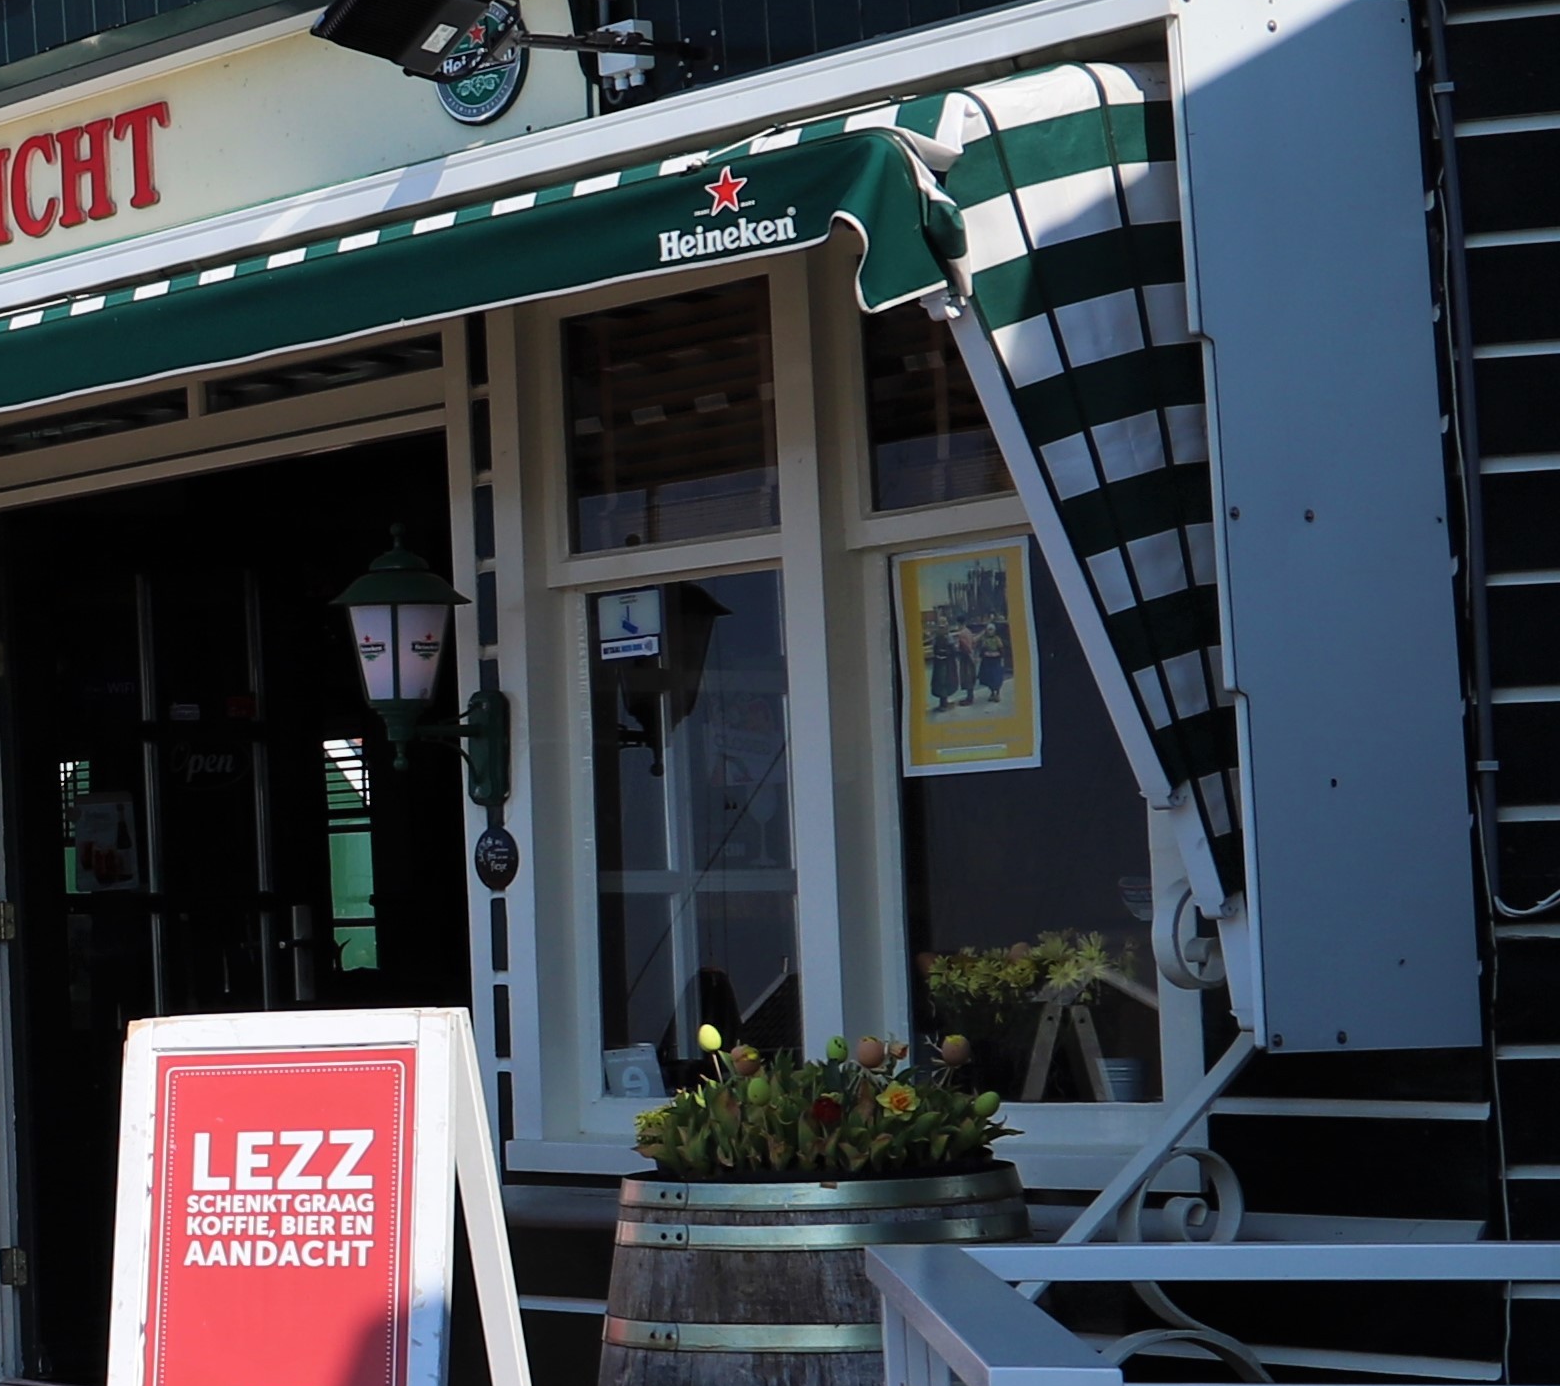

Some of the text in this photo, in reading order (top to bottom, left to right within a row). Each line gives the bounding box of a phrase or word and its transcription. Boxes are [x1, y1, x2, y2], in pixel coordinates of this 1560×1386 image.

[658, 217, 798, 262] Heineken
[191, 1129, 374, 1191] LEZZ
[186, 1193, 374, 1214] SCHENKT GRAAG
[186, 1215, 373, 1238] KOFFIE, BIER EN
[183, 1240, 374, 1267] AANDACHT
